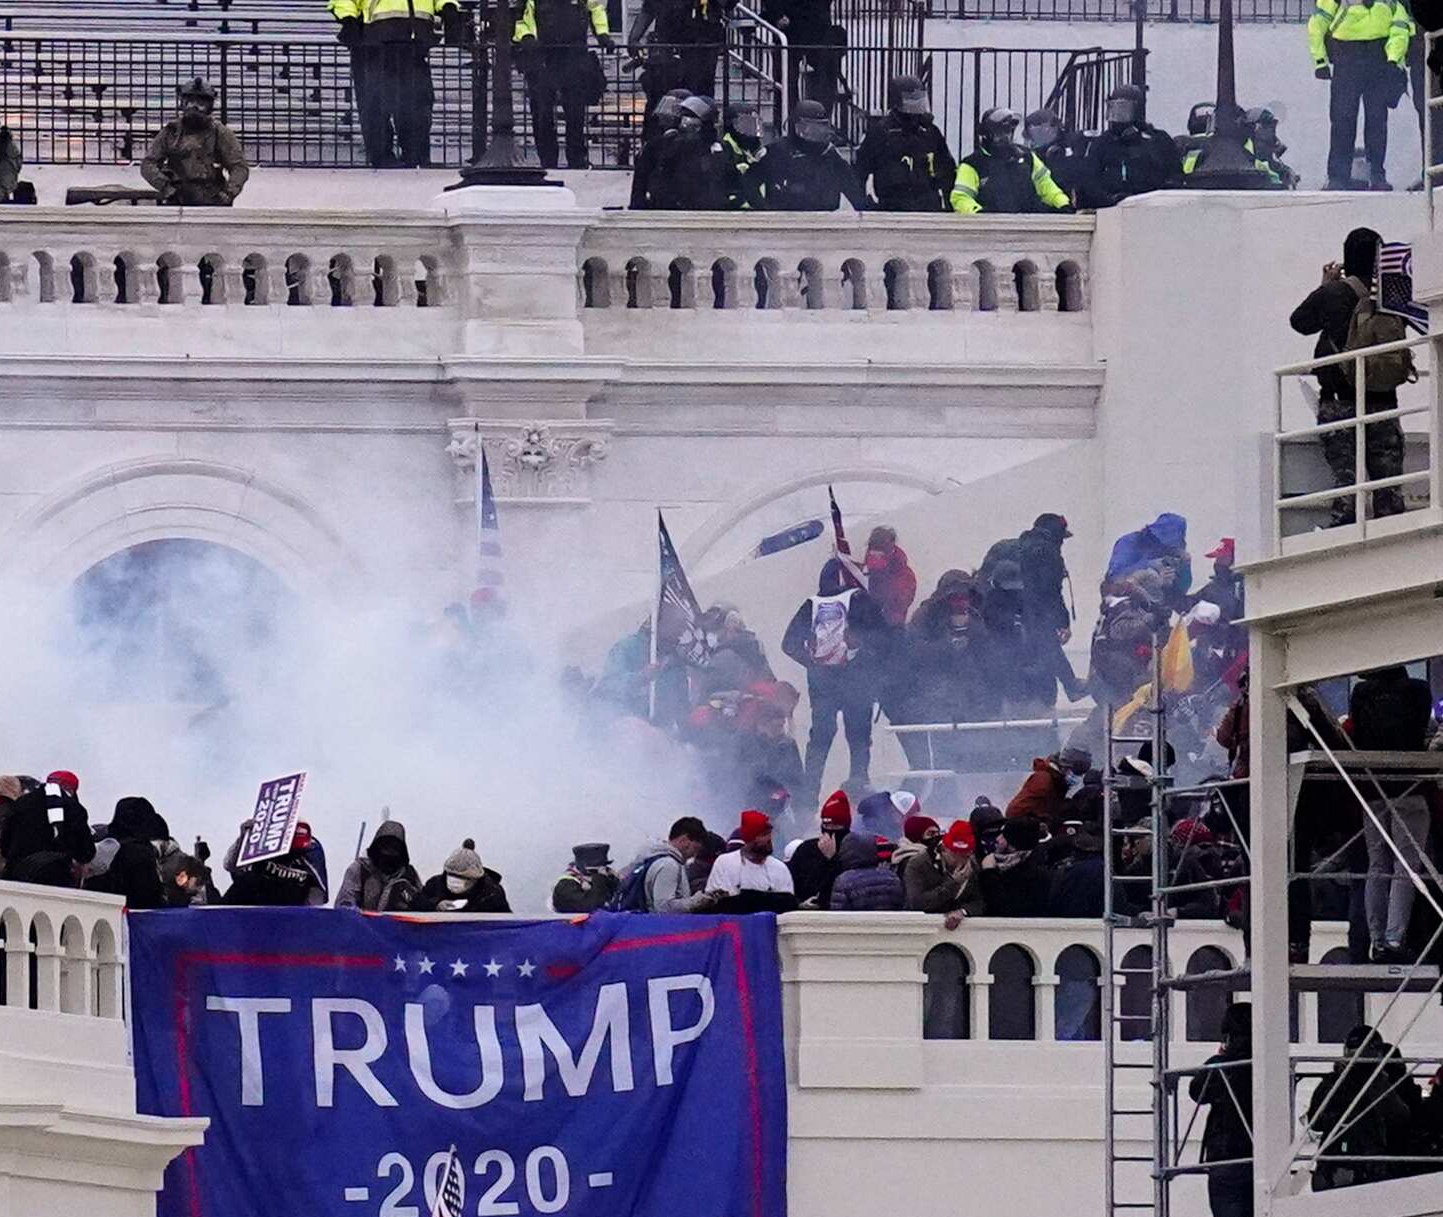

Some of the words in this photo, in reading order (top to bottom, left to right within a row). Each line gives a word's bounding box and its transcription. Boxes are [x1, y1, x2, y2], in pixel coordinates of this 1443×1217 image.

[249, 799, 270, 844] 2020
[264, 778, 297, 852] TRUMP
[206, 973, 716, 1110] TRUMP
